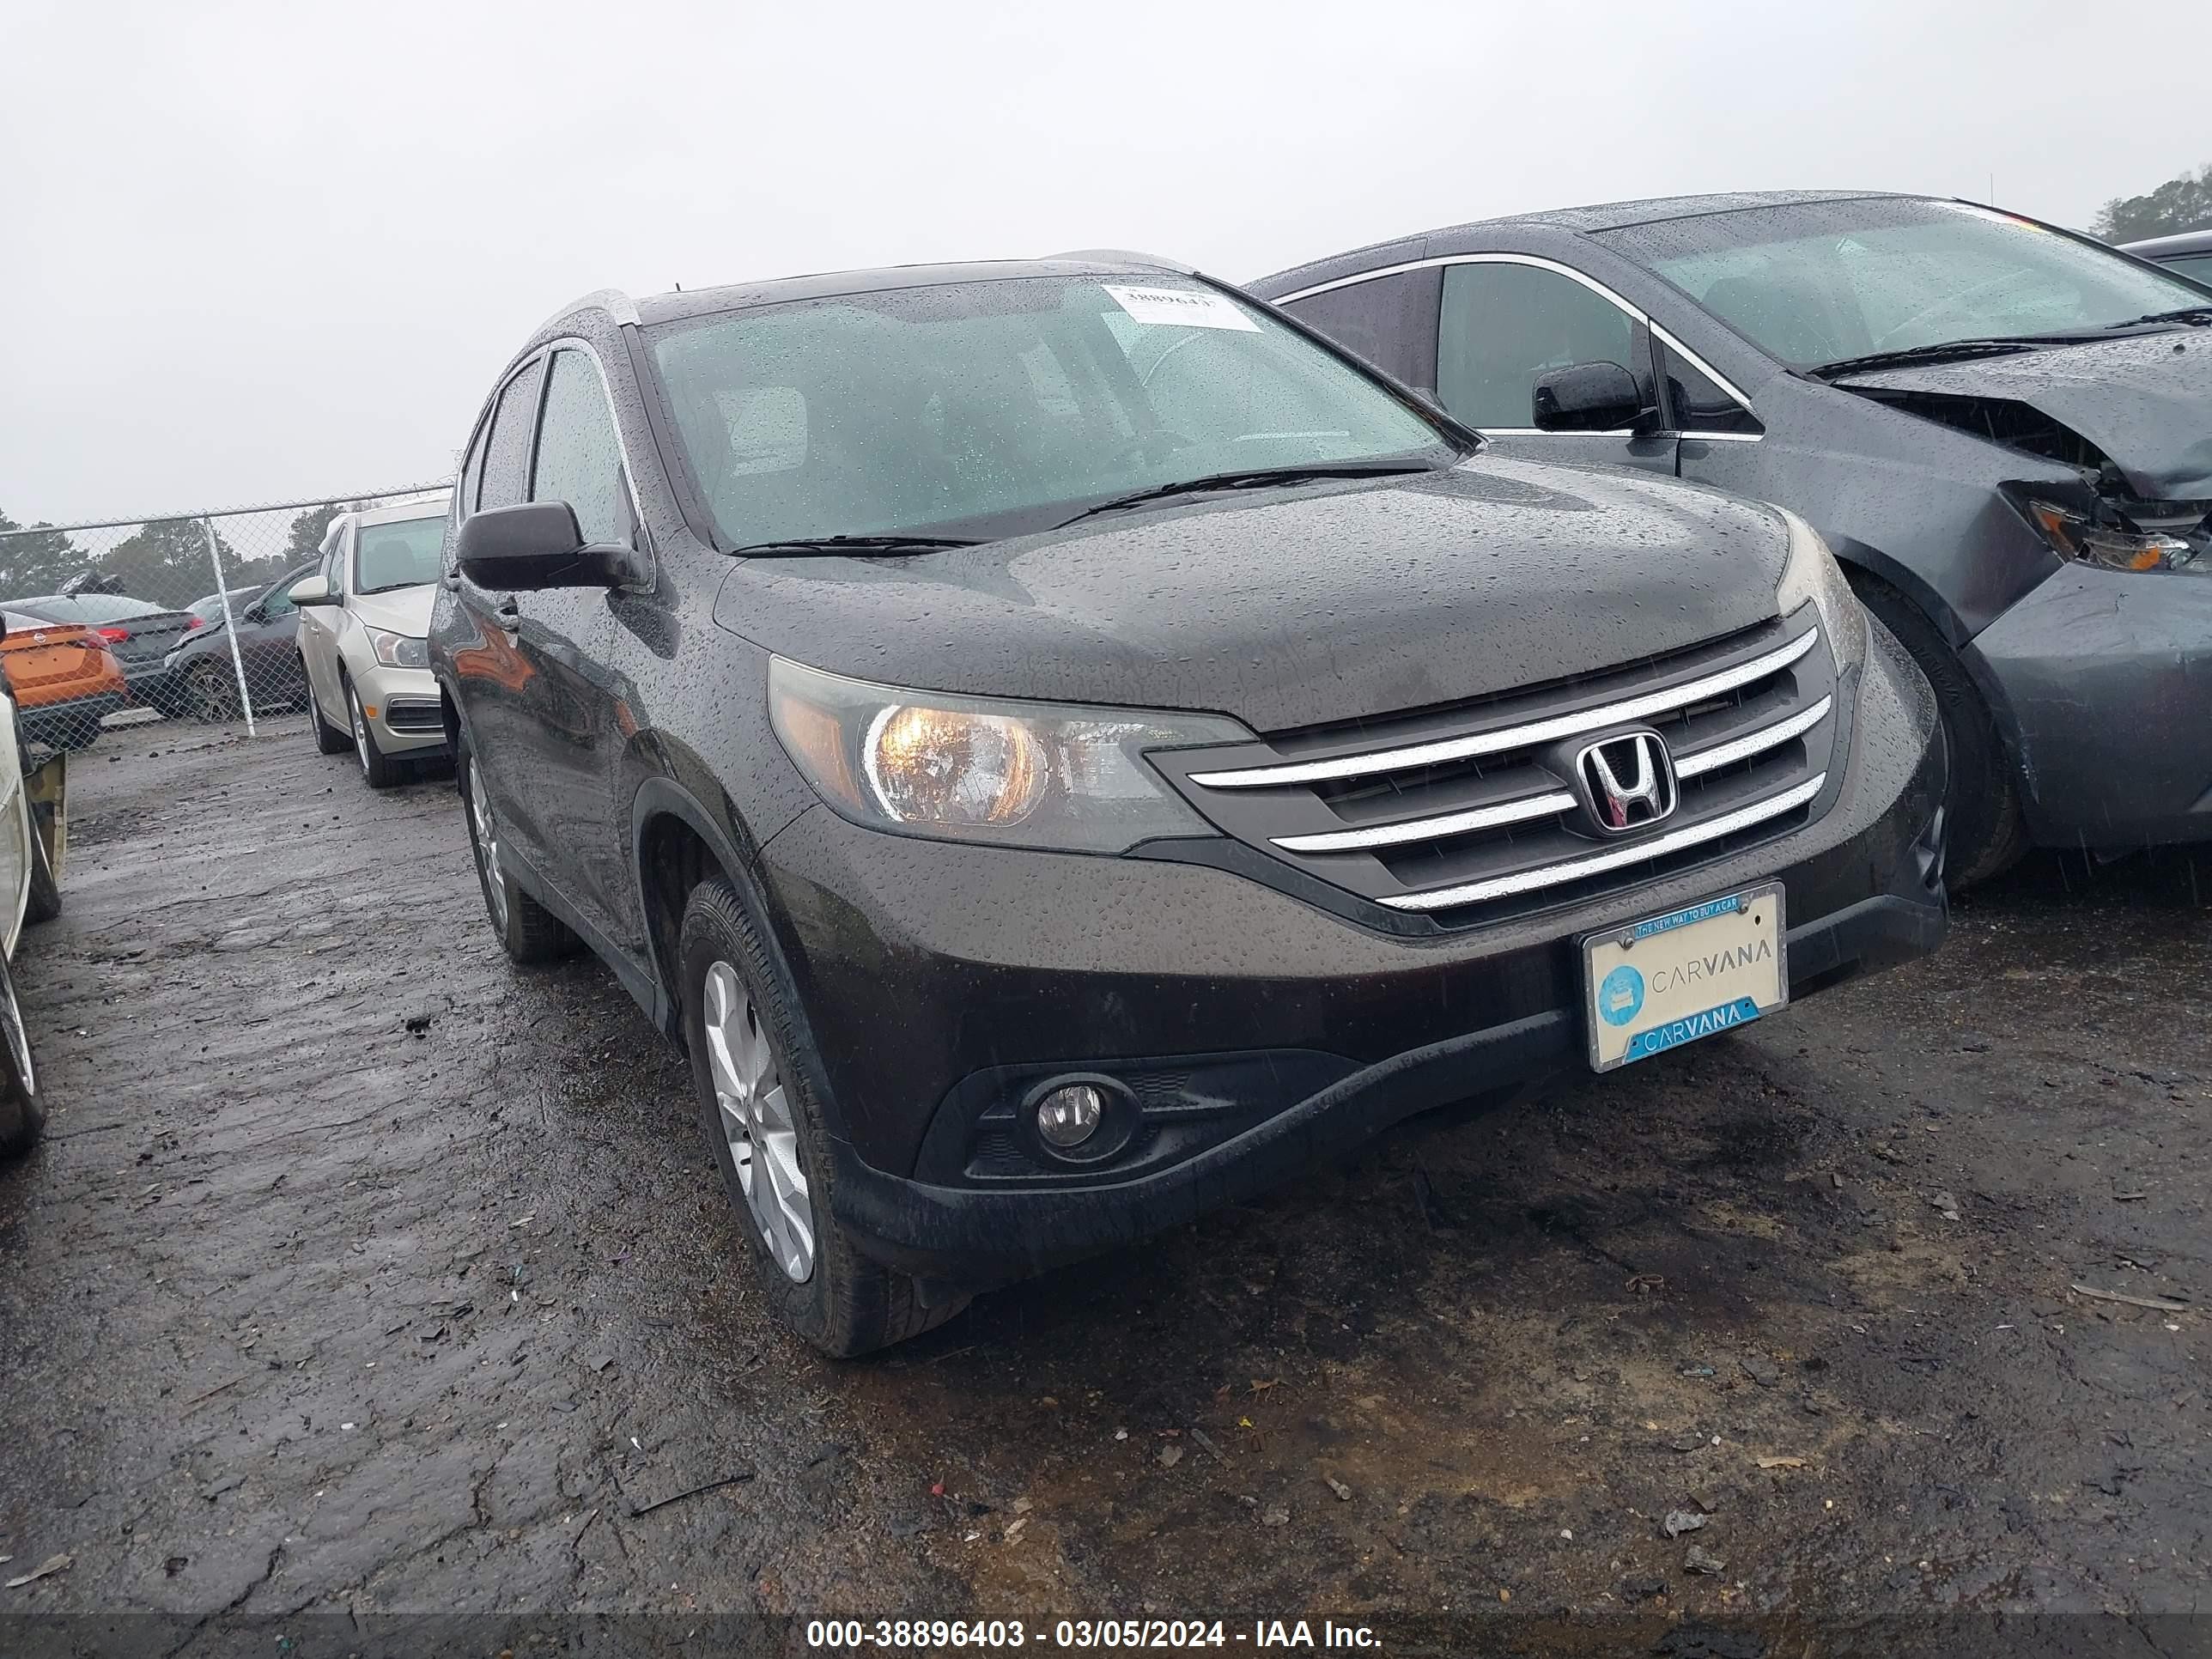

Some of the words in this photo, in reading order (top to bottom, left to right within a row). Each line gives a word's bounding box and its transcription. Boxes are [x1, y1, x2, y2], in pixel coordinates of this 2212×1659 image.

[1637, 925, 1652, 936] THE
[1654, 919, 1671, 931] NEW
[1671, 914, 1688, 926] WAY
[1688, 909, 1698, 921] TO
[1699, 904, 1715, 917] BUY
[1714, 902, 1721, 912] A
[1721, 897, 1737, 910] CAR
[1651, 939, 1771, 994] CARVANA
[1644, 1004, 1741, 1052] CARVANA
